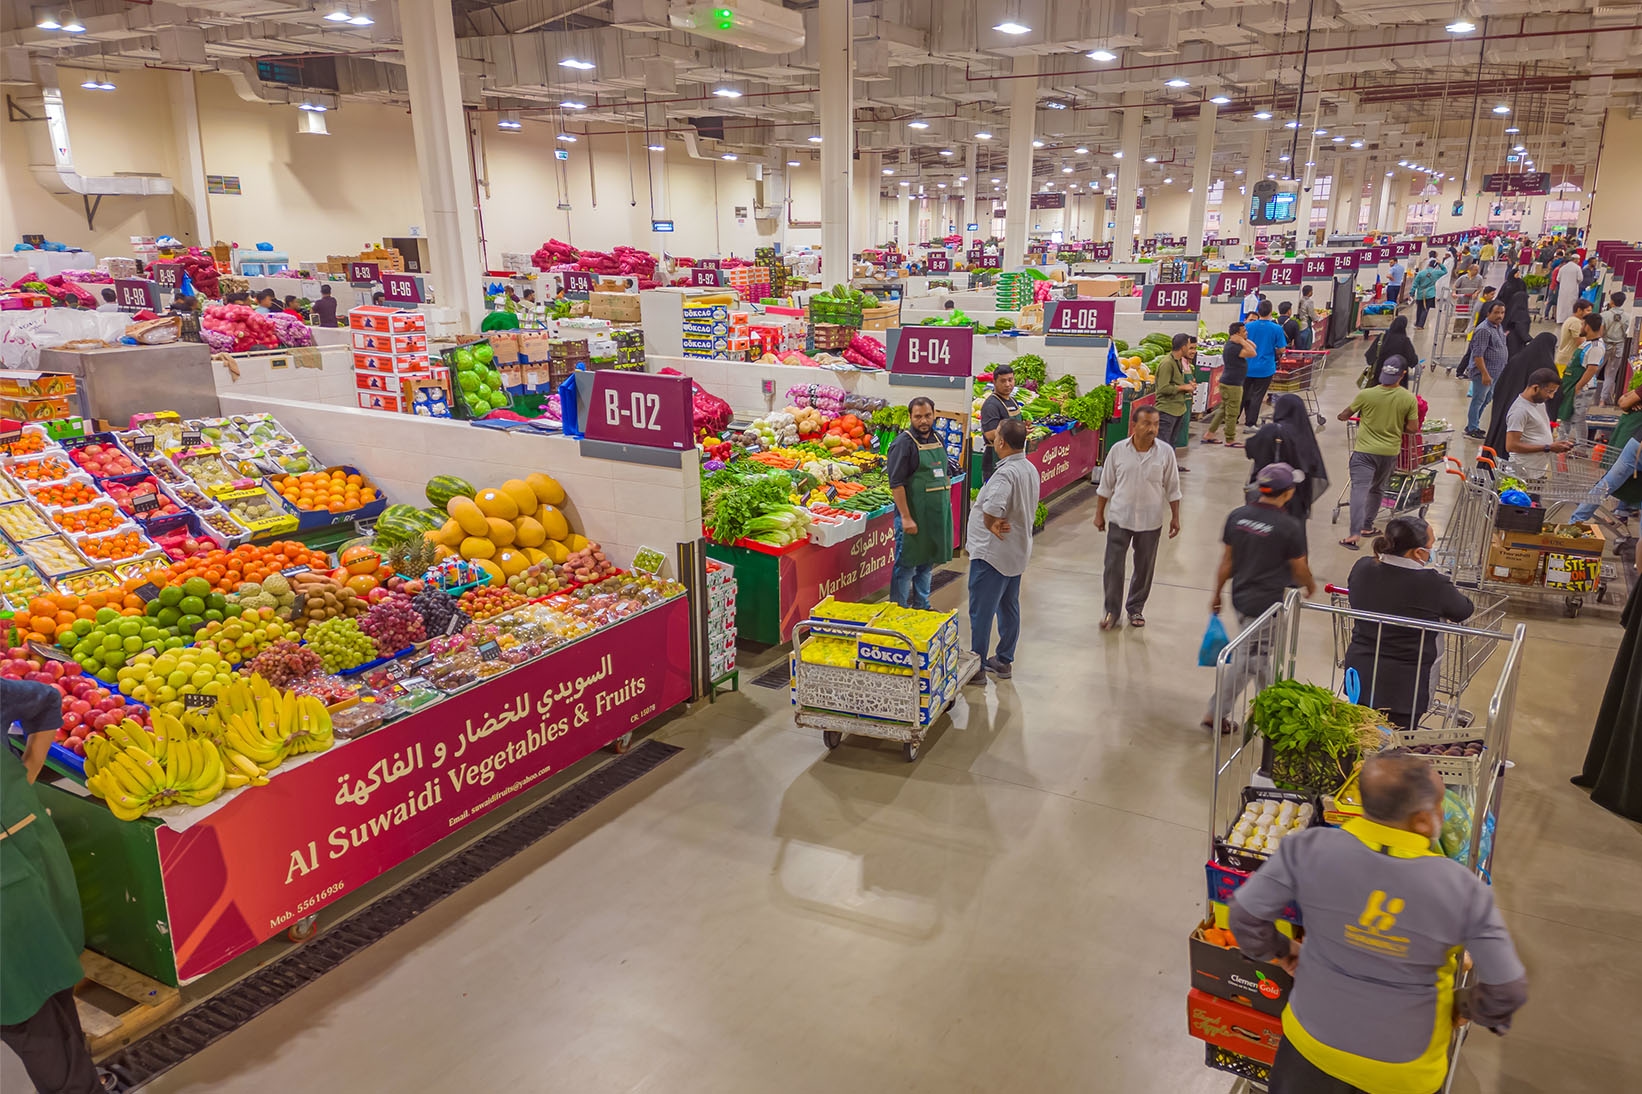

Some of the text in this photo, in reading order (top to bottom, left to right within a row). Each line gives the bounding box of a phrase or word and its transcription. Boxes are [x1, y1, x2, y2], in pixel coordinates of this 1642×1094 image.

[1335, 256, 1351, 266] B-16
[1360, 252, 1372, 261] -18
[354, 266, 371, 279] B-93
[1271, 268, 1292, 280] B-12
[1307, 261, 1325, 273] B-14
[390, 280, 412, 297] B-96
[570, 276, 588, 290] B-94
[698, 273, 714, 285] B-92
[123, 287, 146, 306] B-98
[1157, 290, 1188, 307] B-08
[1061, 309, 1098, 329] B-06
[908, 337, 951, 365] B-04
[604, 388, 661, 431] B-02
[1041, 467, 1055, 483] Beirut
[1055, 460, 1070, 475] Fruits
[818, 570, 858, 600] Markaz
[860, 555, 886, 578] Zahra
[334, 653, 613, 806] السويدي للخضار و الفاكهة
[284, 677, 646, 885] Al Suwaidi Vegetables & Fruits
[448, 765, 551, 827] Email. suwaidifruits@yahoo.com
[269, 880, 345, 929] Mob. 55616936
